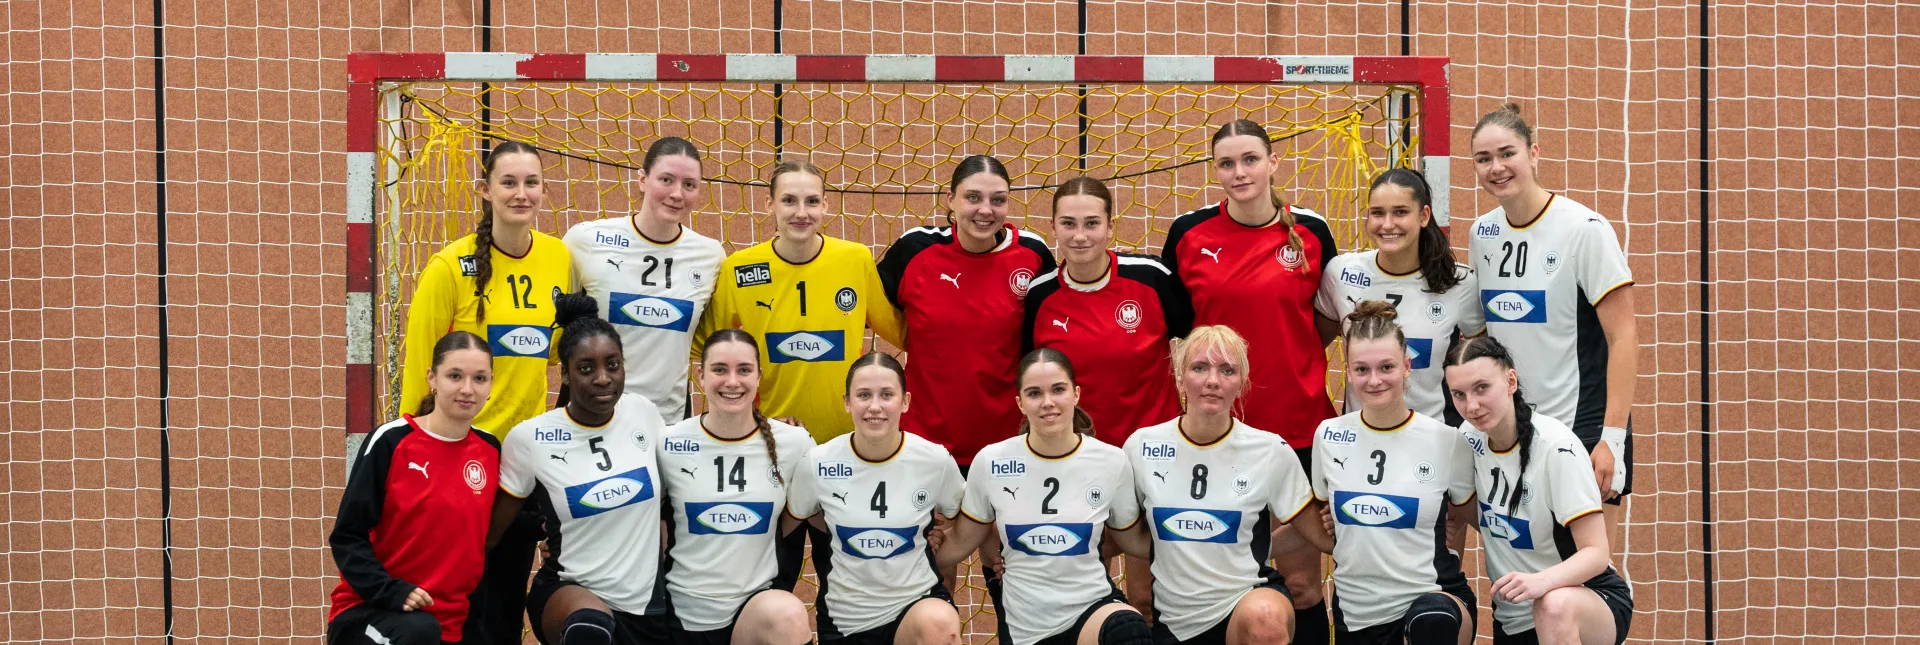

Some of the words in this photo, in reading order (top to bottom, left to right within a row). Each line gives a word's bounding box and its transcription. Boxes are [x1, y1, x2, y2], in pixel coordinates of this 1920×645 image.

[1477, 222, 1501, 236] hella
[596, 231, 630, 248] hella
[1498, 241, 1528, 278] 20
[641, 255, 674, 289] 21
[735, 267, 770, 284] hella
[1340, 268, 1371, 287] hella
[507, 274, 537, 309] 12
[796, 281, 807, 316] 1
[634, 305, 669, 318] TENA
[1496, 301, 1523, 311] TENA
[510, 335, 541, 346] TENA
[788, 341, 820, 351] TENA
[535, 428, 572, 441] hella
[1323, 426, 1357, 443] hella
[664, 438, 700, 452] hella
[1142, 442, 1176, 458] hella
[588, 435, 613, 472] 5
[713, 455, 747, 493] 14
[818, 462, 853, 477] hella
[991, 460, 1026, 474] hella
[1367, 449, 1387, 486] 3
[1189, 463, 1209, 500] 8
[592, 484, 631, 502] TENA
[870, 481, 888, 519] 4
[1041, 477, 1060, 515] 2
[709, 513, 747, 523] TENA
[1351, 503, 1390, 517] TENA
[1176, 519, 1214, 531] TENA
[858, 537, 894, 549] TENA
[1028, 534, 1067, 545] TENA
